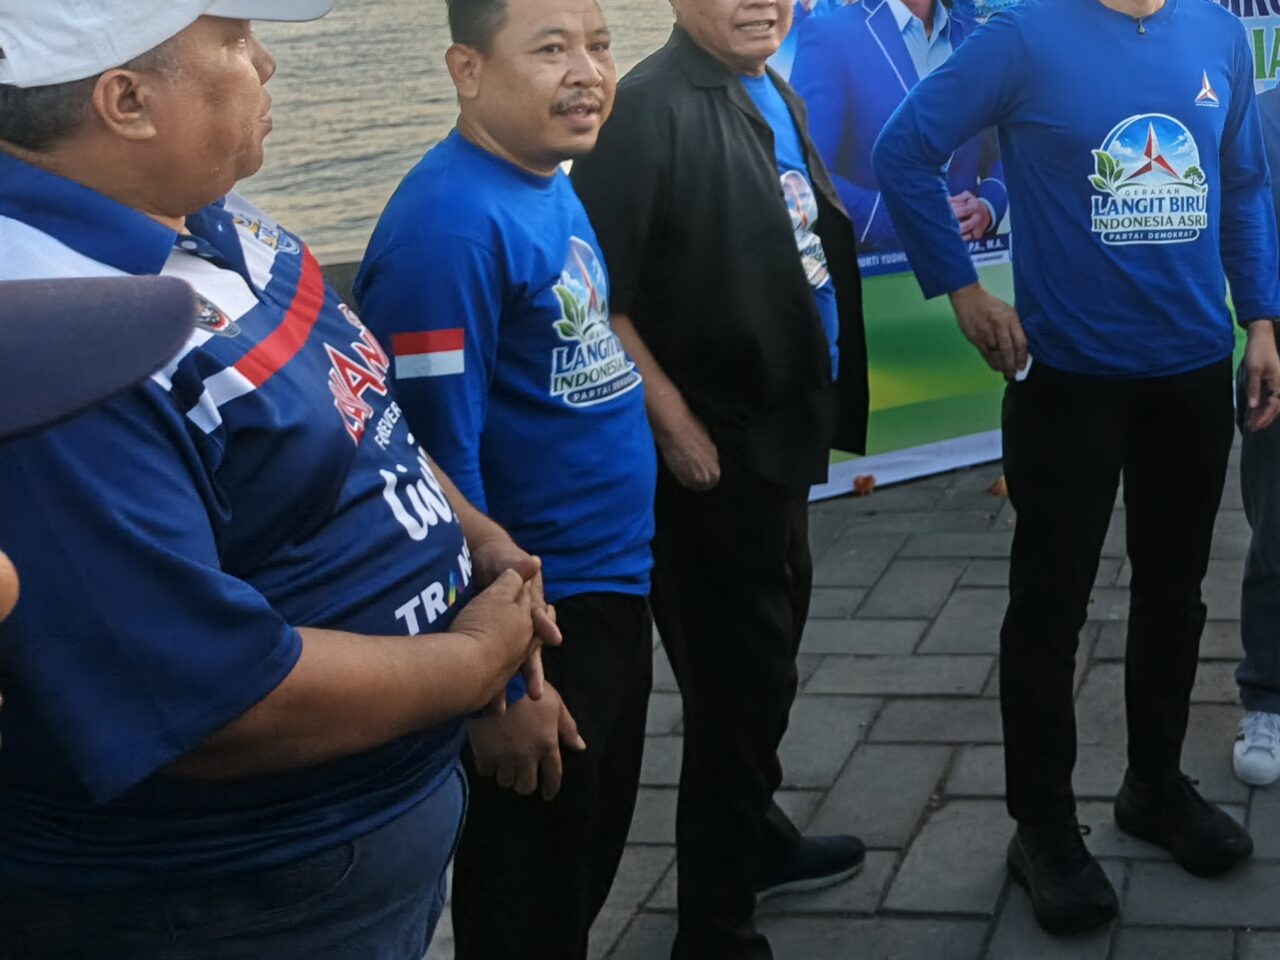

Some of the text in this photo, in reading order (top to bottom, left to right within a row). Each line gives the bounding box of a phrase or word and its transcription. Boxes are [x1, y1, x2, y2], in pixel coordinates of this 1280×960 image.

[1125, 188, 1180, 196] GERAKAN
[1093, 195, 1206, 216] LANGIT BIRU
[1094, 215, 1206, 230] INDONESIA ASRI
[1109, 230, 1193, 240] PARTAI DEMOKRAT
[395, 537, 473, 637] TRAN
